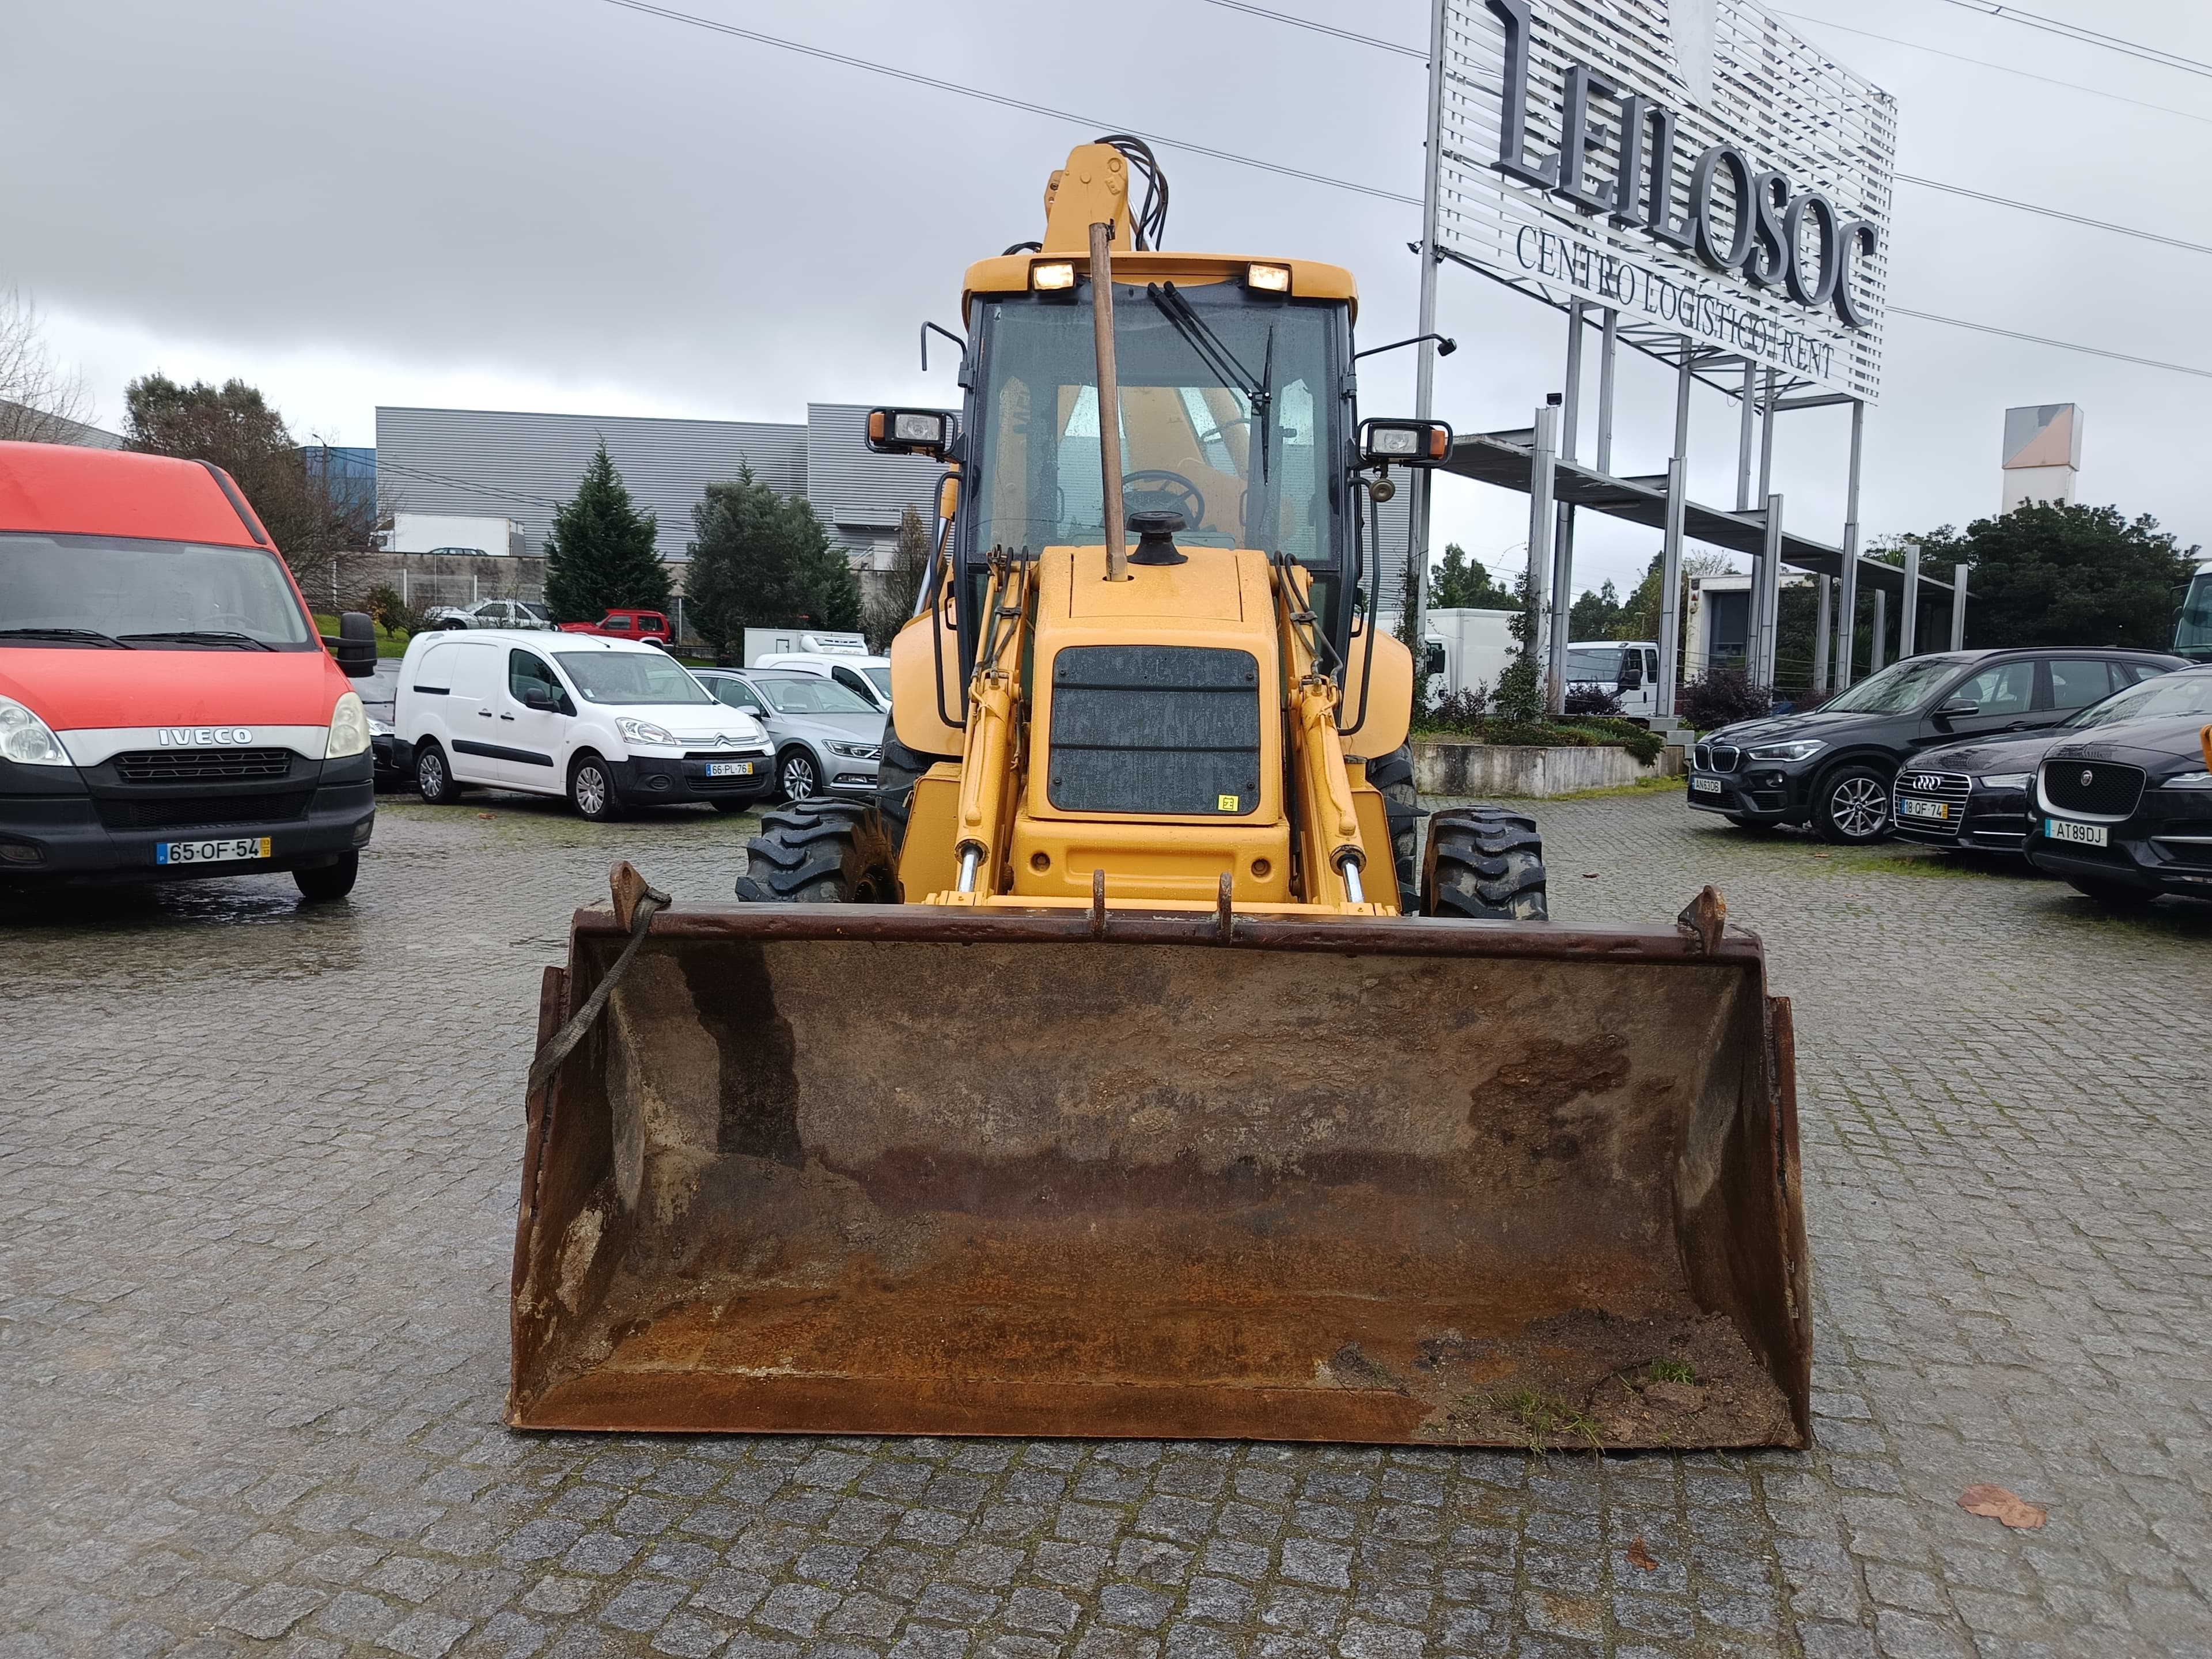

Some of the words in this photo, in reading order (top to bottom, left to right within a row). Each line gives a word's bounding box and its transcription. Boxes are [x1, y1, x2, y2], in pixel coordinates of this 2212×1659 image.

[1485, 0, 1878, 327] LEILOSOC
[1516, 225, 1635, 305] CENTRO
[1781, 329, 1835, 379] RENT
[158, 728, 253, 745] IVECO
[1696, 779, 1719, 791] AN63DB
[2056, 823, 2101, 843] AT89DJ
